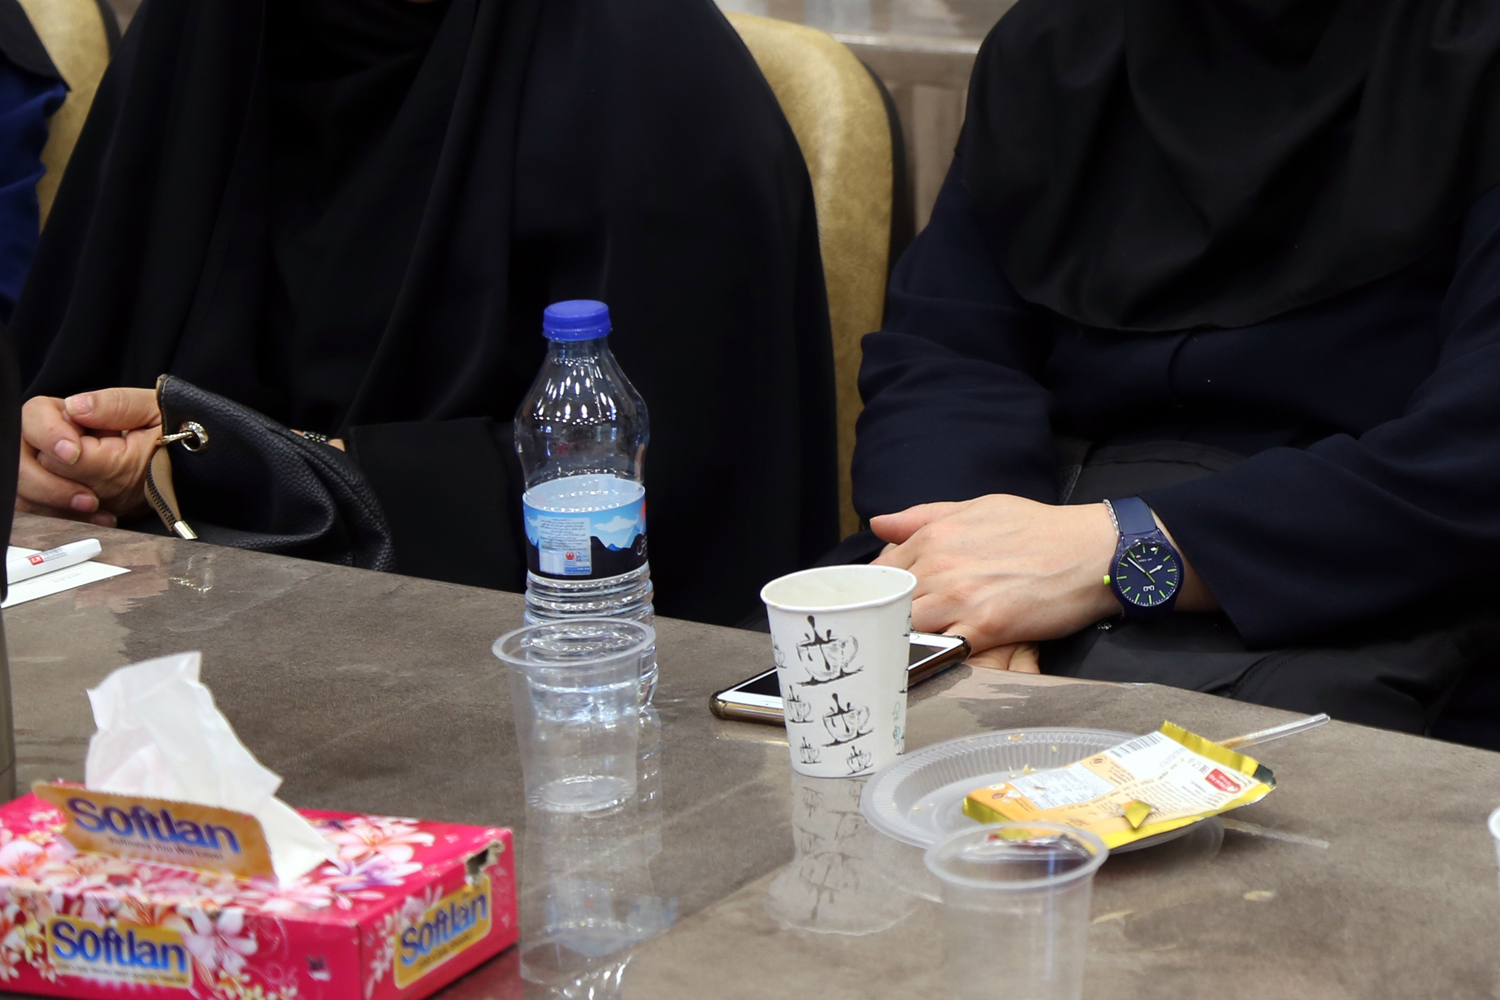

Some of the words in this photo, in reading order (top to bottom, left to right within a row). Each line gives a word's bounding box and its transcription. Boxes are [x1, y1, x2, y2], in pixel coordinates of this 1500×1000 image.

[67, 797, 241, 854] Softlan
[52, 920, 187, 973] Softlan
[401, 893, 487, 967] Softlan
